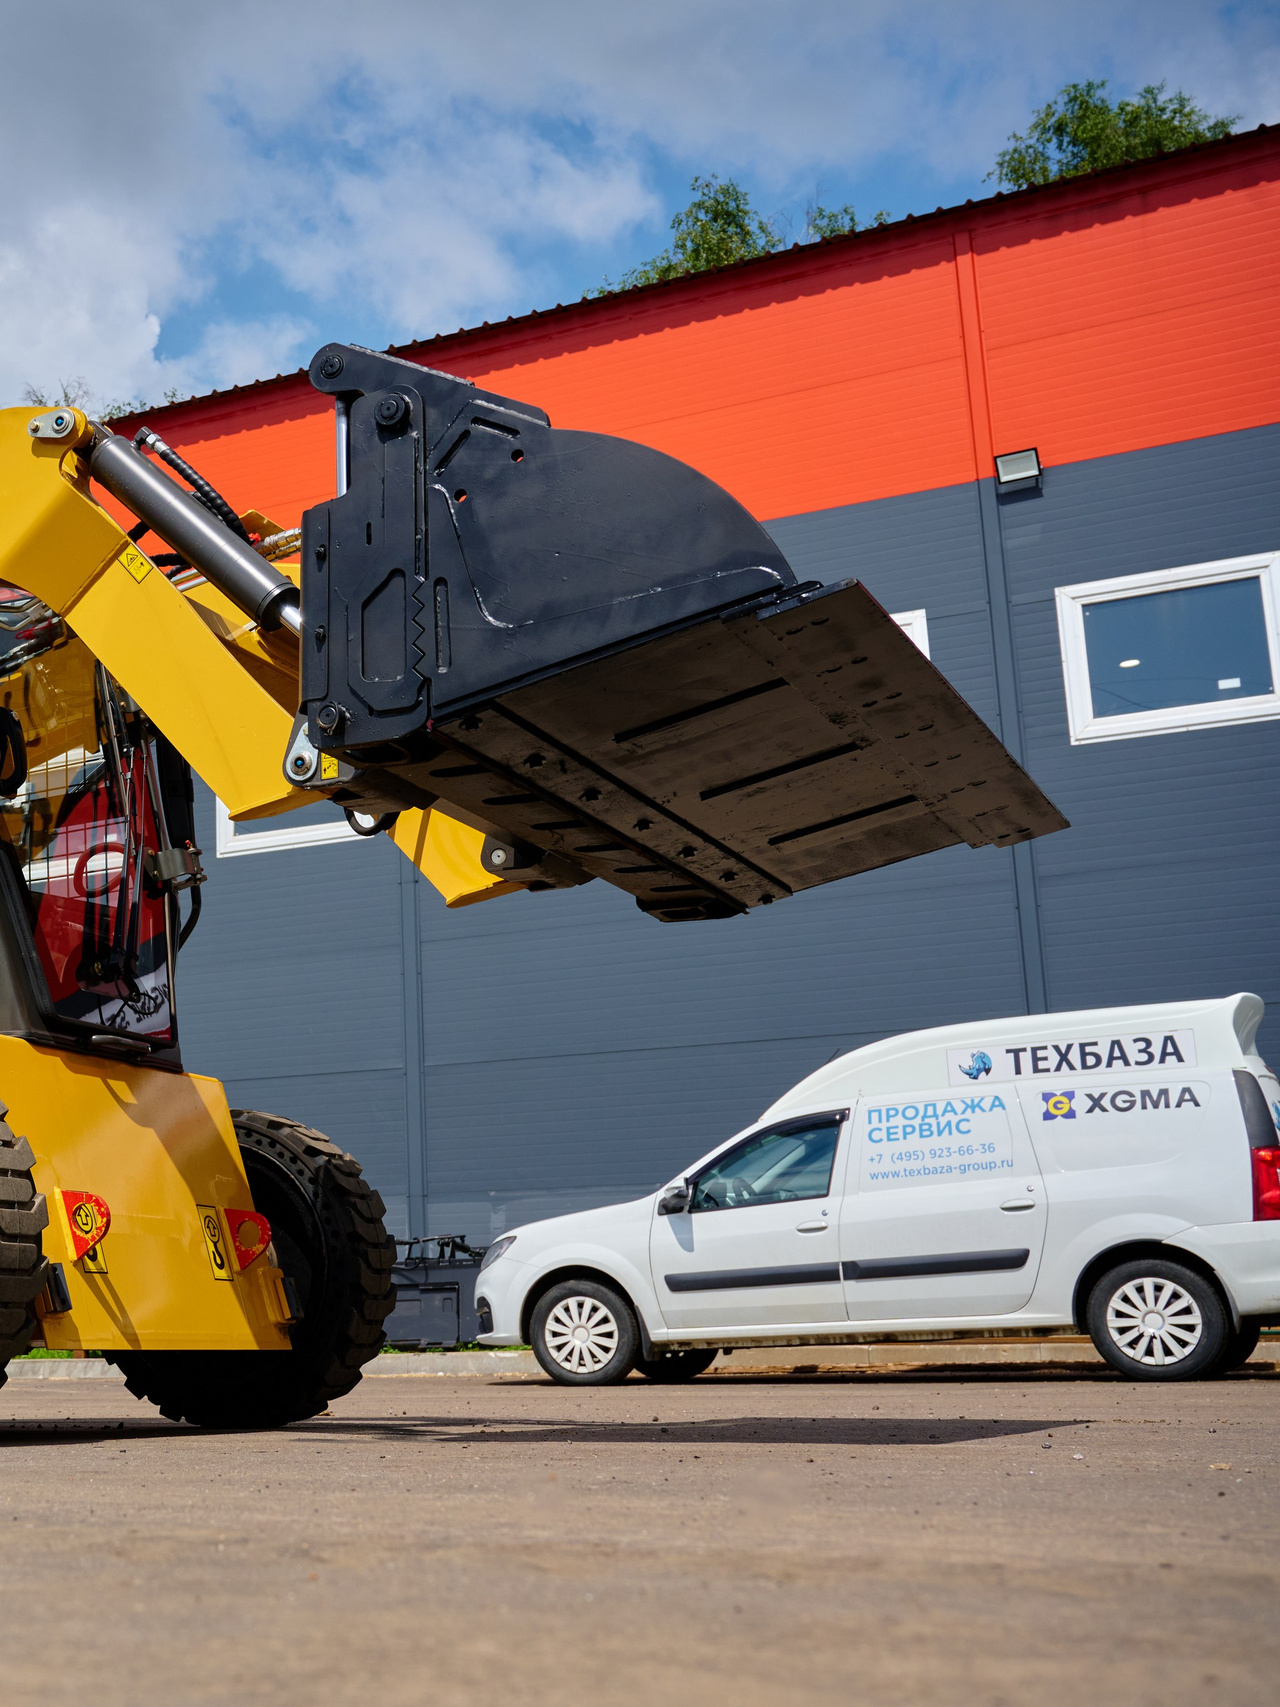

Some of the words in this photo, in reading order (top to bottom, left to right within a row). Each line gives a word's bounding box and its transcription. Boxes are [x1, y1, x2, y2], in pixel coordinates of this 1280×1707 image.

[1006, 1035, 1185, 1076] ТЕХБАЗА
[868, 1095, 1006, 1125] ПРОДАЖА
[1085, 1087, 1201, 1114] XGMA
[868, 1118, 972, 1143] СЕРВИС
[868, 1154, 883, 1164] +7
[890, 1150, 925, 1163] (495)
[929, 1143, 995, 1159] 923-66-36
[869, 1158, 1013, 1180] www.texbaza-group.ru
